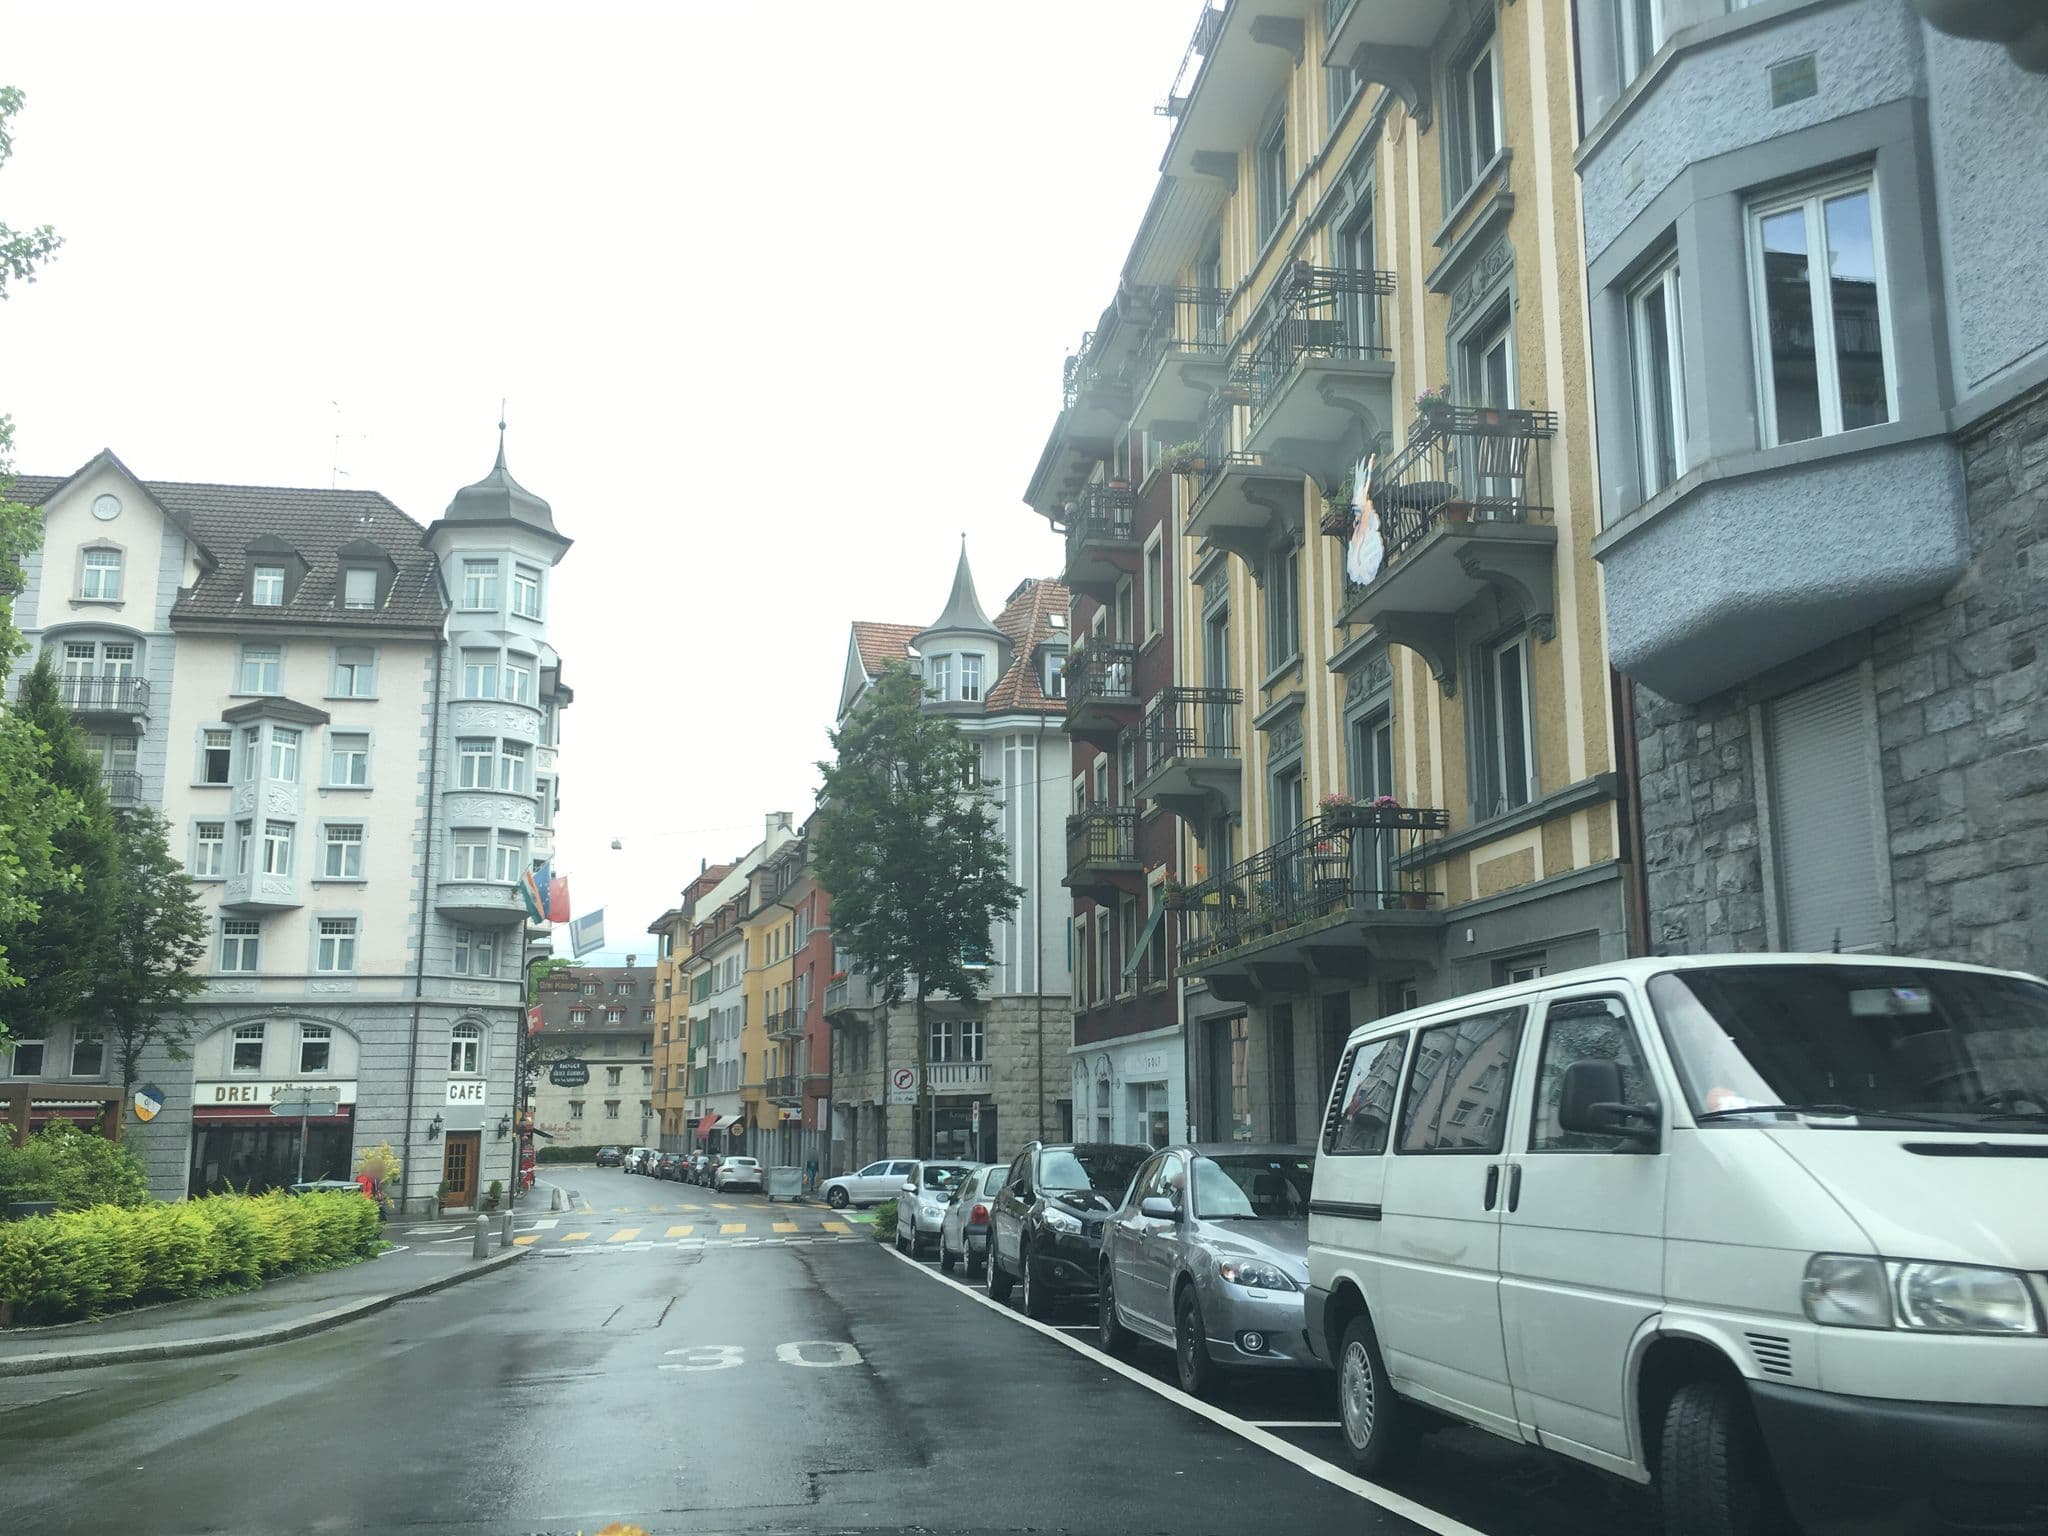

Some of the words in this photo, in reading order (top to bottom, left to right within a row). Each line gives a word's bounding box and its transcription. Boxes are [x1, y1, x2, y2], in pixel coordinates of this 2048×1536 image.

[215, 1086, 258, 1102] DREI
[450, 1080, 483, 1099] CAFÉ
[657, 1340, 865, 1371] 30
